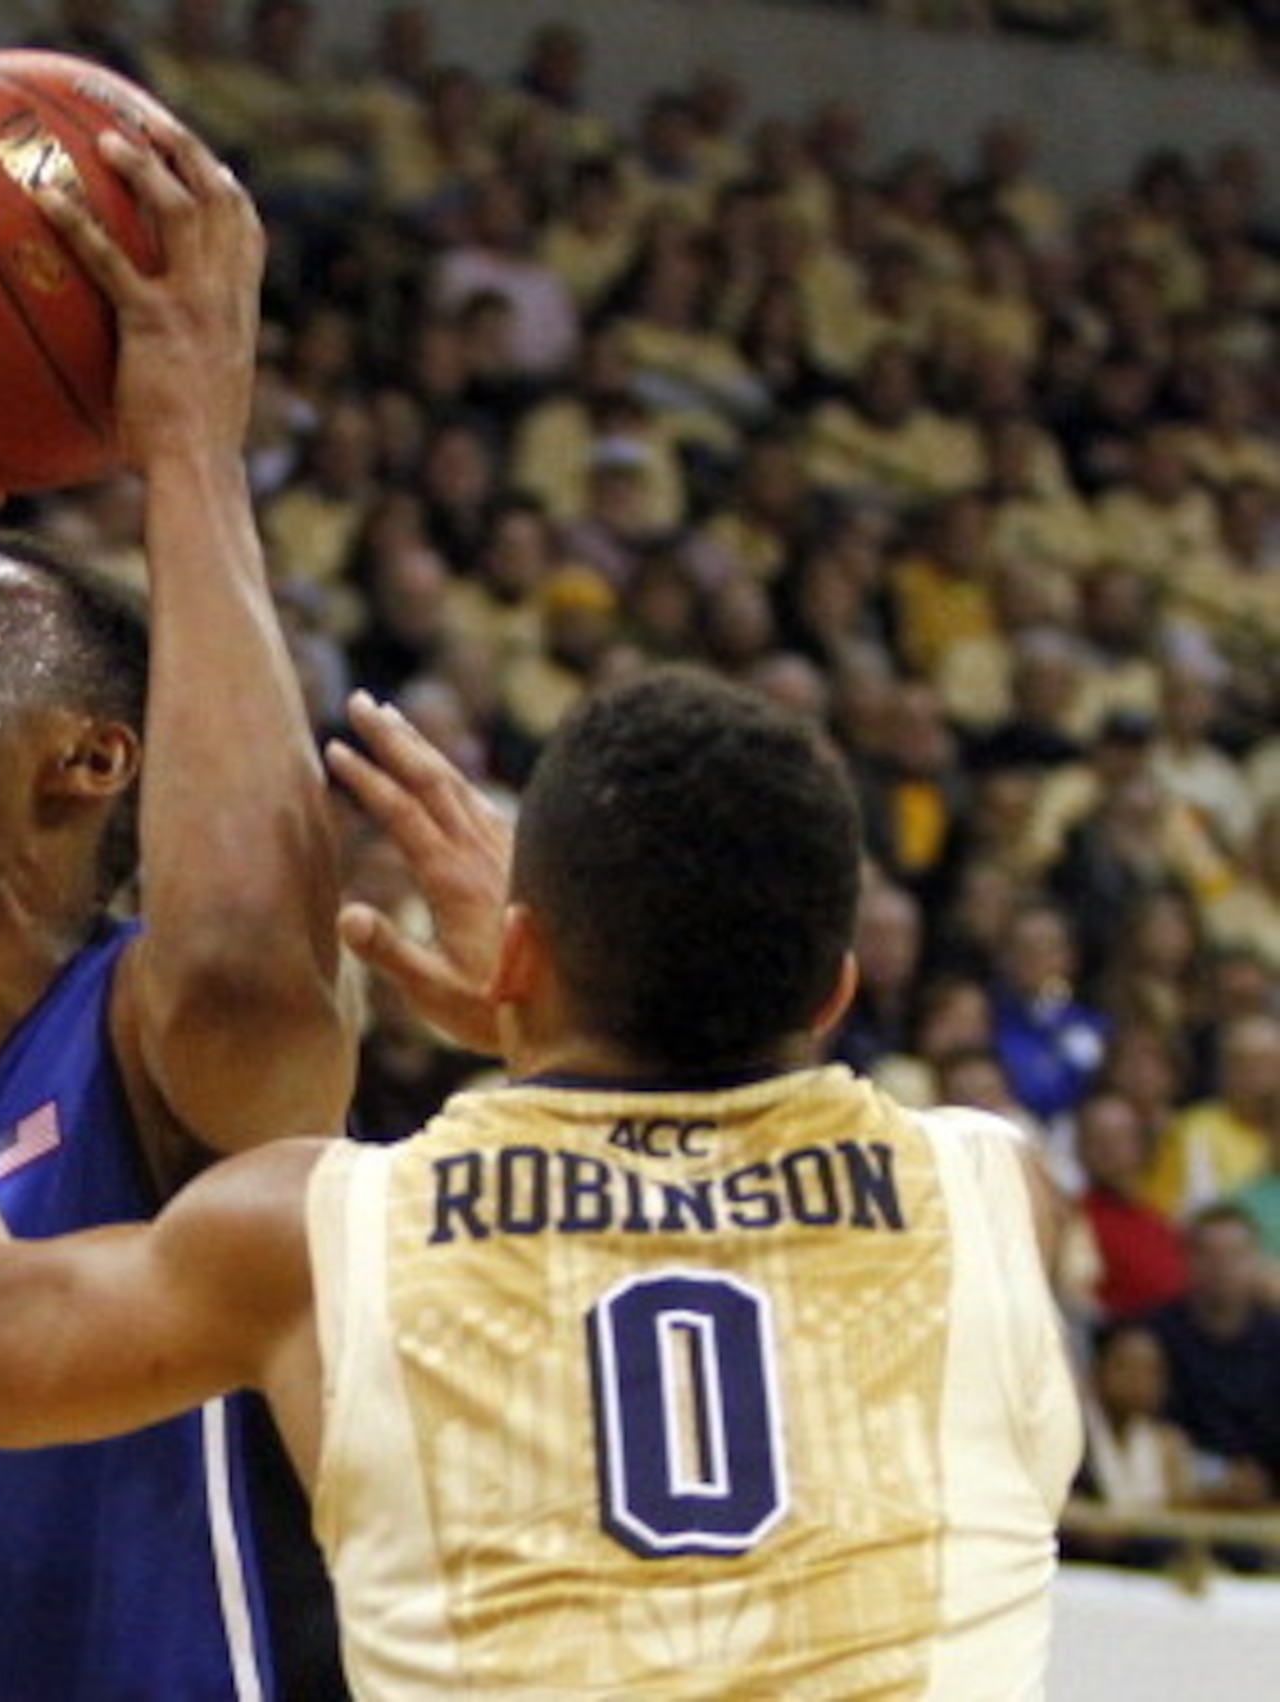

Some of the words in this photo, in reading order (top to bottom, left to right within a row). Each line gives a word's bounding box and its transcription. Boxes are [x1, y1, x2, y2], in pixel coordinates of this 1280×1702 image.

[608, 1118, 718, 1157] ACC
[427, 1140, 905, 1245] ROBINSON
[586, 1267, 789, 1560] 0
